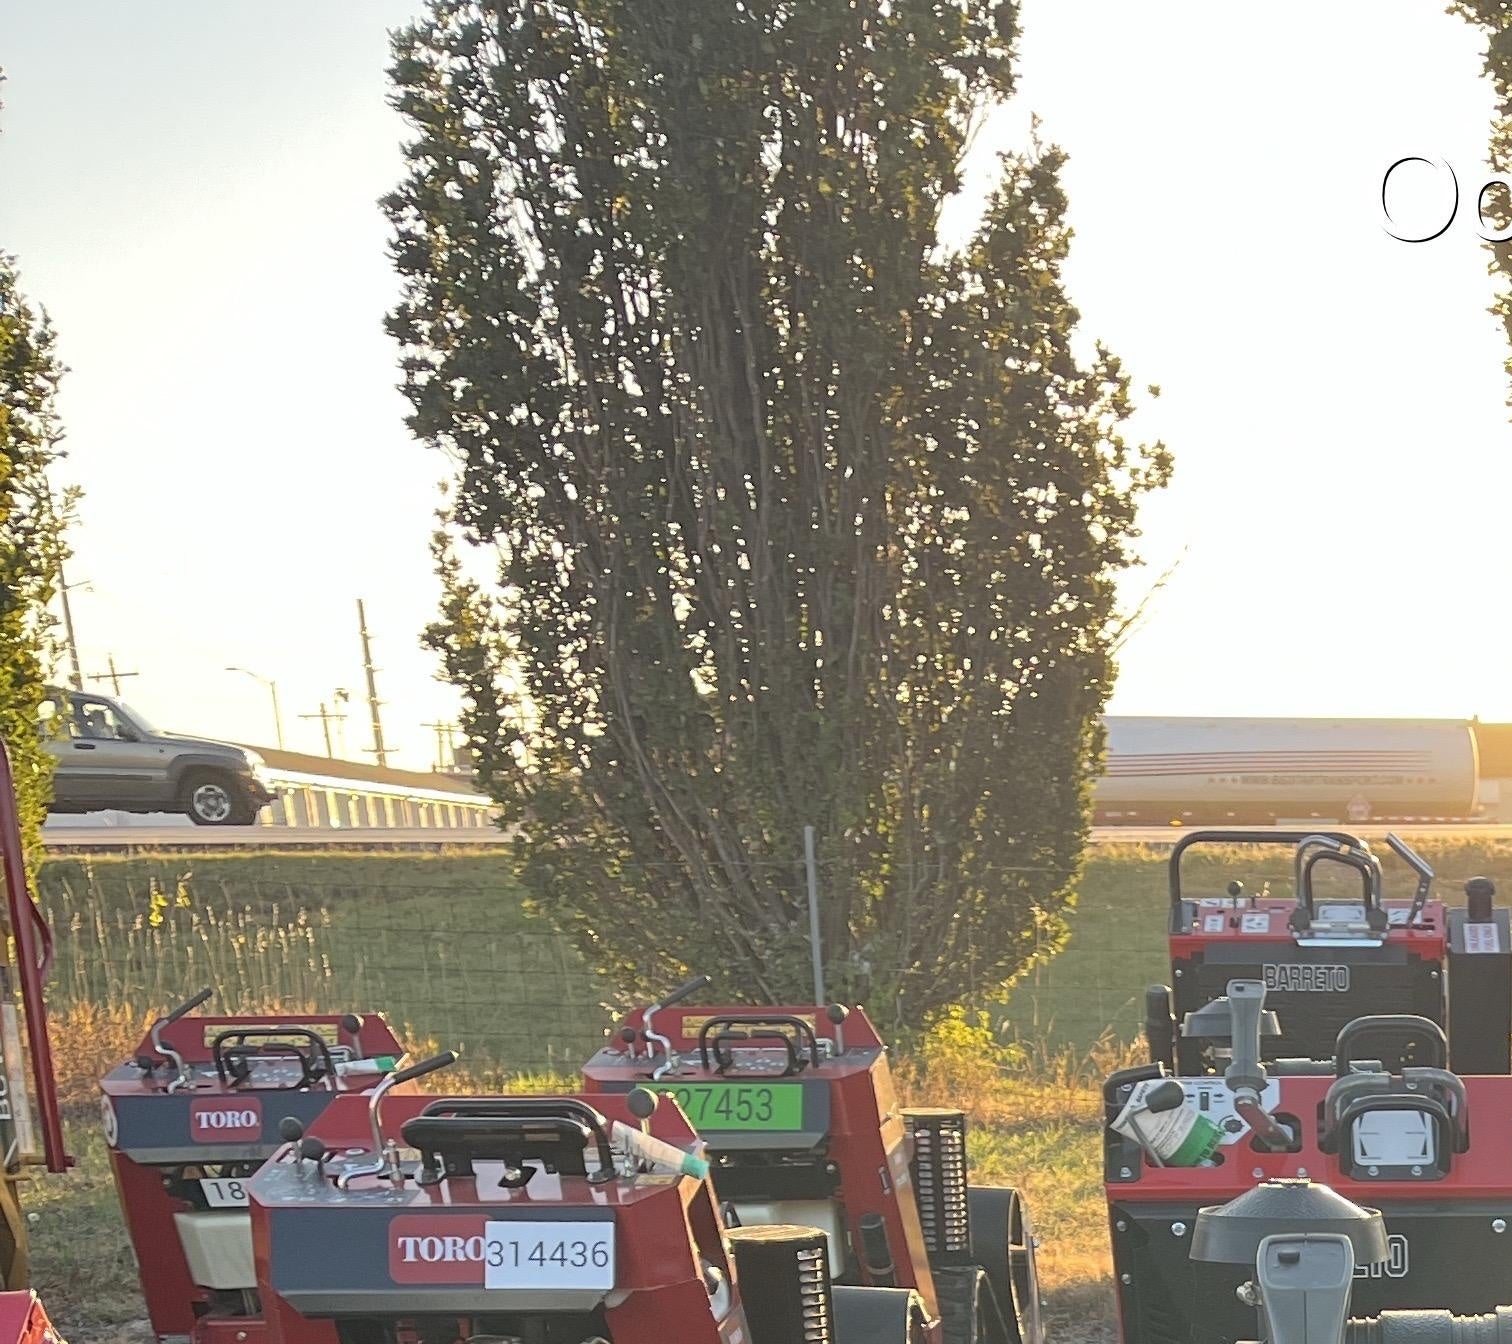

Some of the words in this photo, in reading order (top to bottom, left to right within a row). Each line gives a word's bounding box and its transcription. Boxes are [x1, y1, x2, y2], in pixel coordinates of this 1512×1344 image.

[1262, 963, 1349, 992] BARRETO
[658, 1088, 773, 1121] 27453
[195, 1110, 257, 1129] TORO
[398, 1235, 486, 1263] TORO
[487, 1240, 609, 1268] 314436
